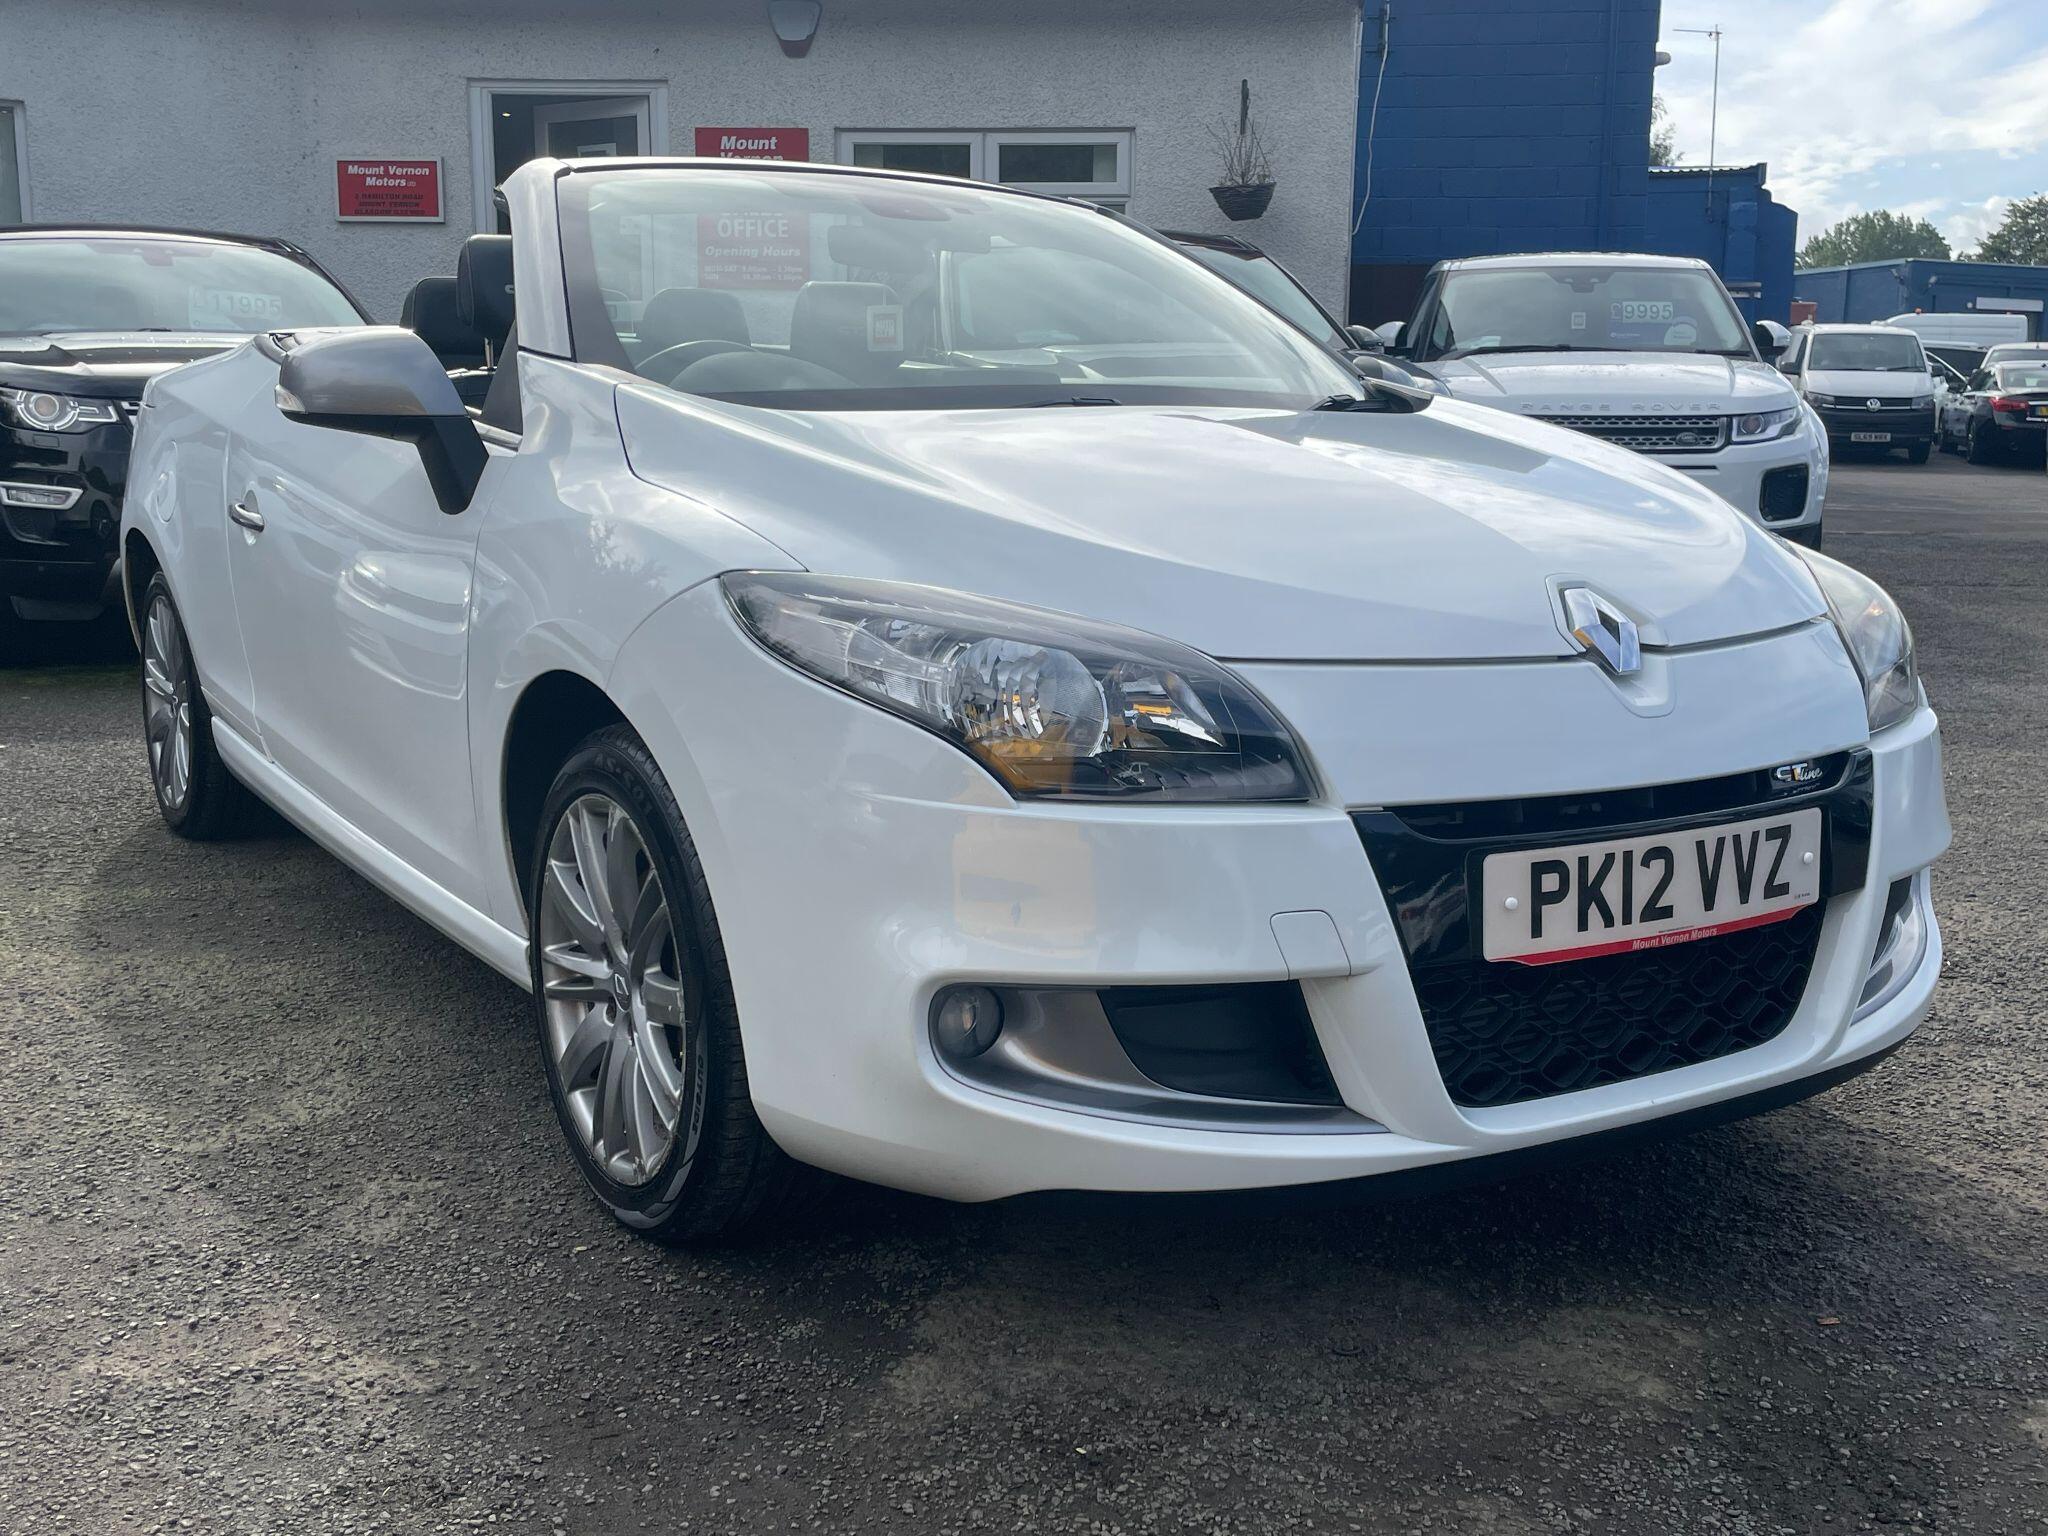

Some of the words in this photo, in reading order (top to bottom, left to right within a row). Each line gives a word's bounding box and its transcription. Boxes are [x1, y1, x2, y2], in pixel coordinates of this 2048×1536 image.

[720, 135, 778, 150] Mount
[347, 165, 385, 175] Mount
[388, 165, 430, 176] Vernon
[365, 177, 407, 187] Motors
[717, 218, 789, 238] OFFICE
[704, 245, 760, 258] Opening
[762, 245, 801, 257] Hours
[1520, 402, 1612, 412] RANGE
[1631, 402, 1721, 412] ROVER
[1530, 845, 1675, 940] PK12
[1695, 823, 1793, 913] VVZ
[1632, 938, 1659, 950] Mount
[1660, 932, 1690, 945] Vernon
[1690, 927, 1718, 941] Motors
